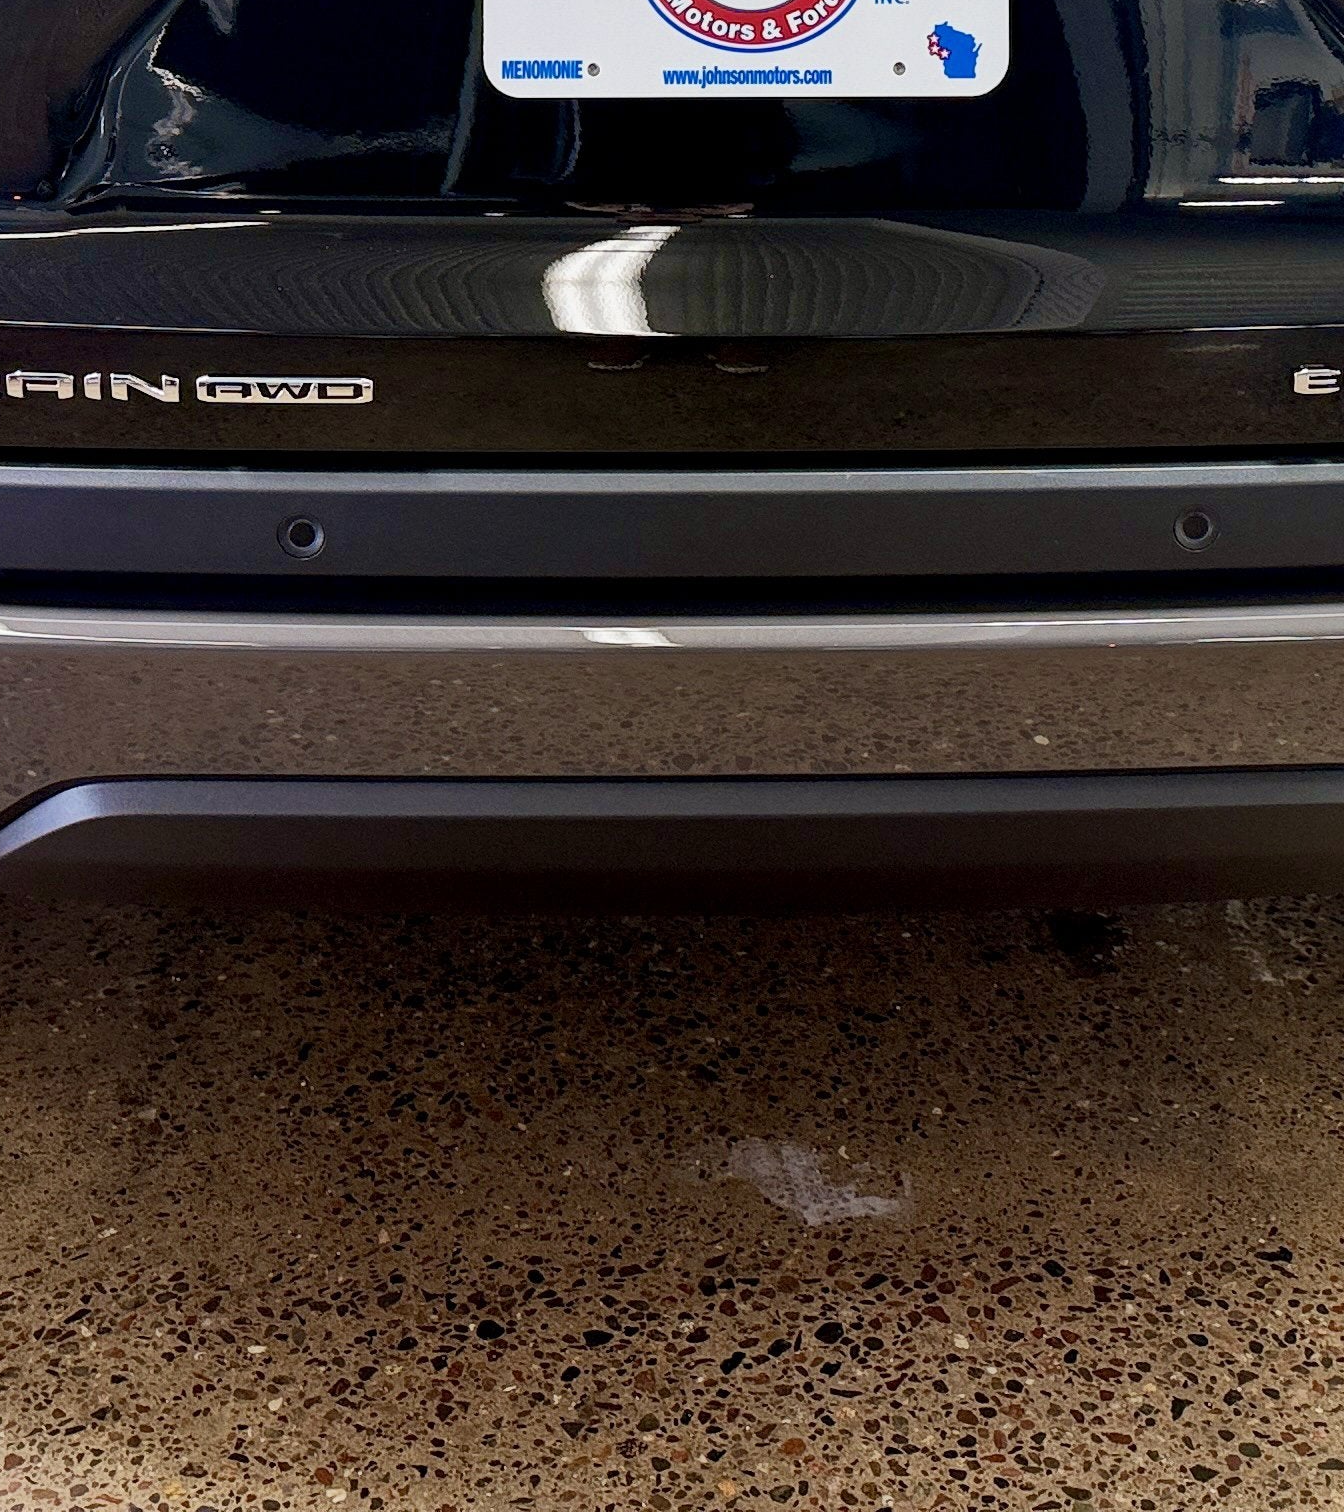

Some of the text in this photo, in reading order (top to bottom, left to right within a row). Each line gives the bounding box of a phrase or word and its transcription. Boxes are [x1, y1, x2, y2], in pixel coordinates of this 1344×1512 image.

[761, 19, 784, 40] &
[502, 60, 583, 80] MENOMONIE
[663, 66, 833, 88] www.johnsonmotors.com
[204, 378, 363, 402] AWD
